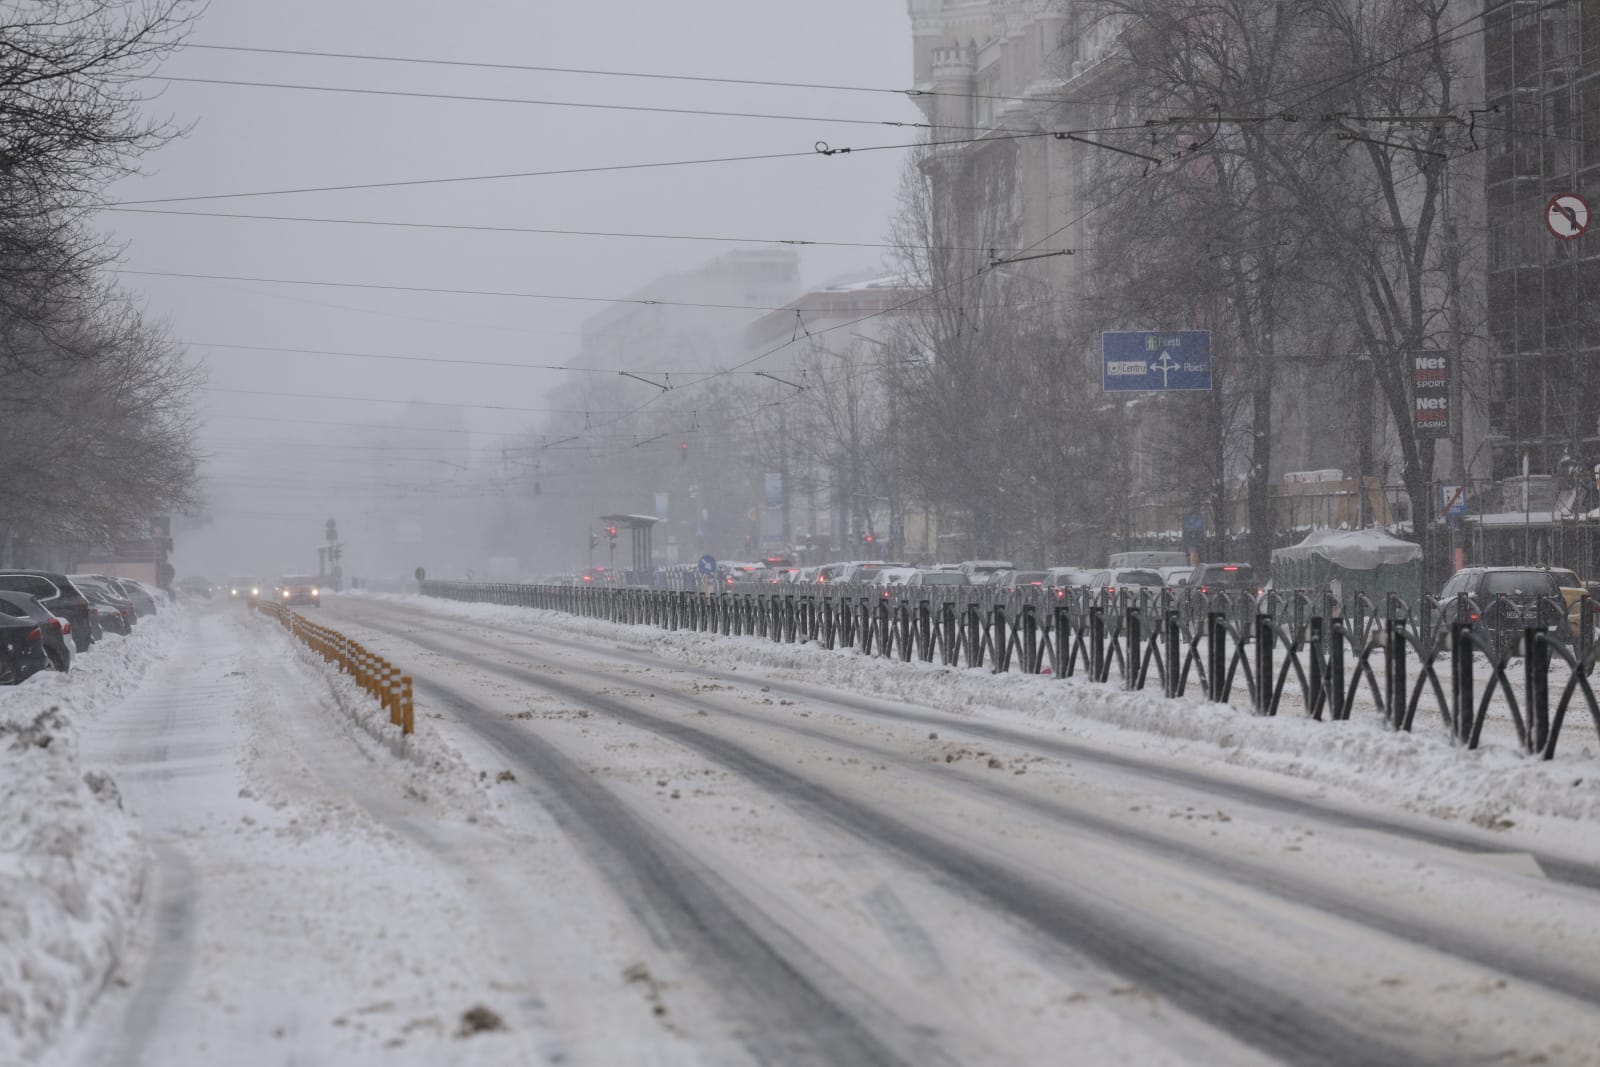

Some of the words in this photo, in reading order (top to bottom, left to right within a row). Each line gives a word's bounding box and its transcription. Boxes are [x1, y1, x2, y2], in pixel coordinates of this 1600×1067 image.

[1122, 363, 1146, 373] Centru
[1415, 357, 1446, 370] Net
[1416, 380, 1445, 389] SPORT
[1416, 397, 1447, 409] Net
[1417, 421, 1447, 429] CASINO
